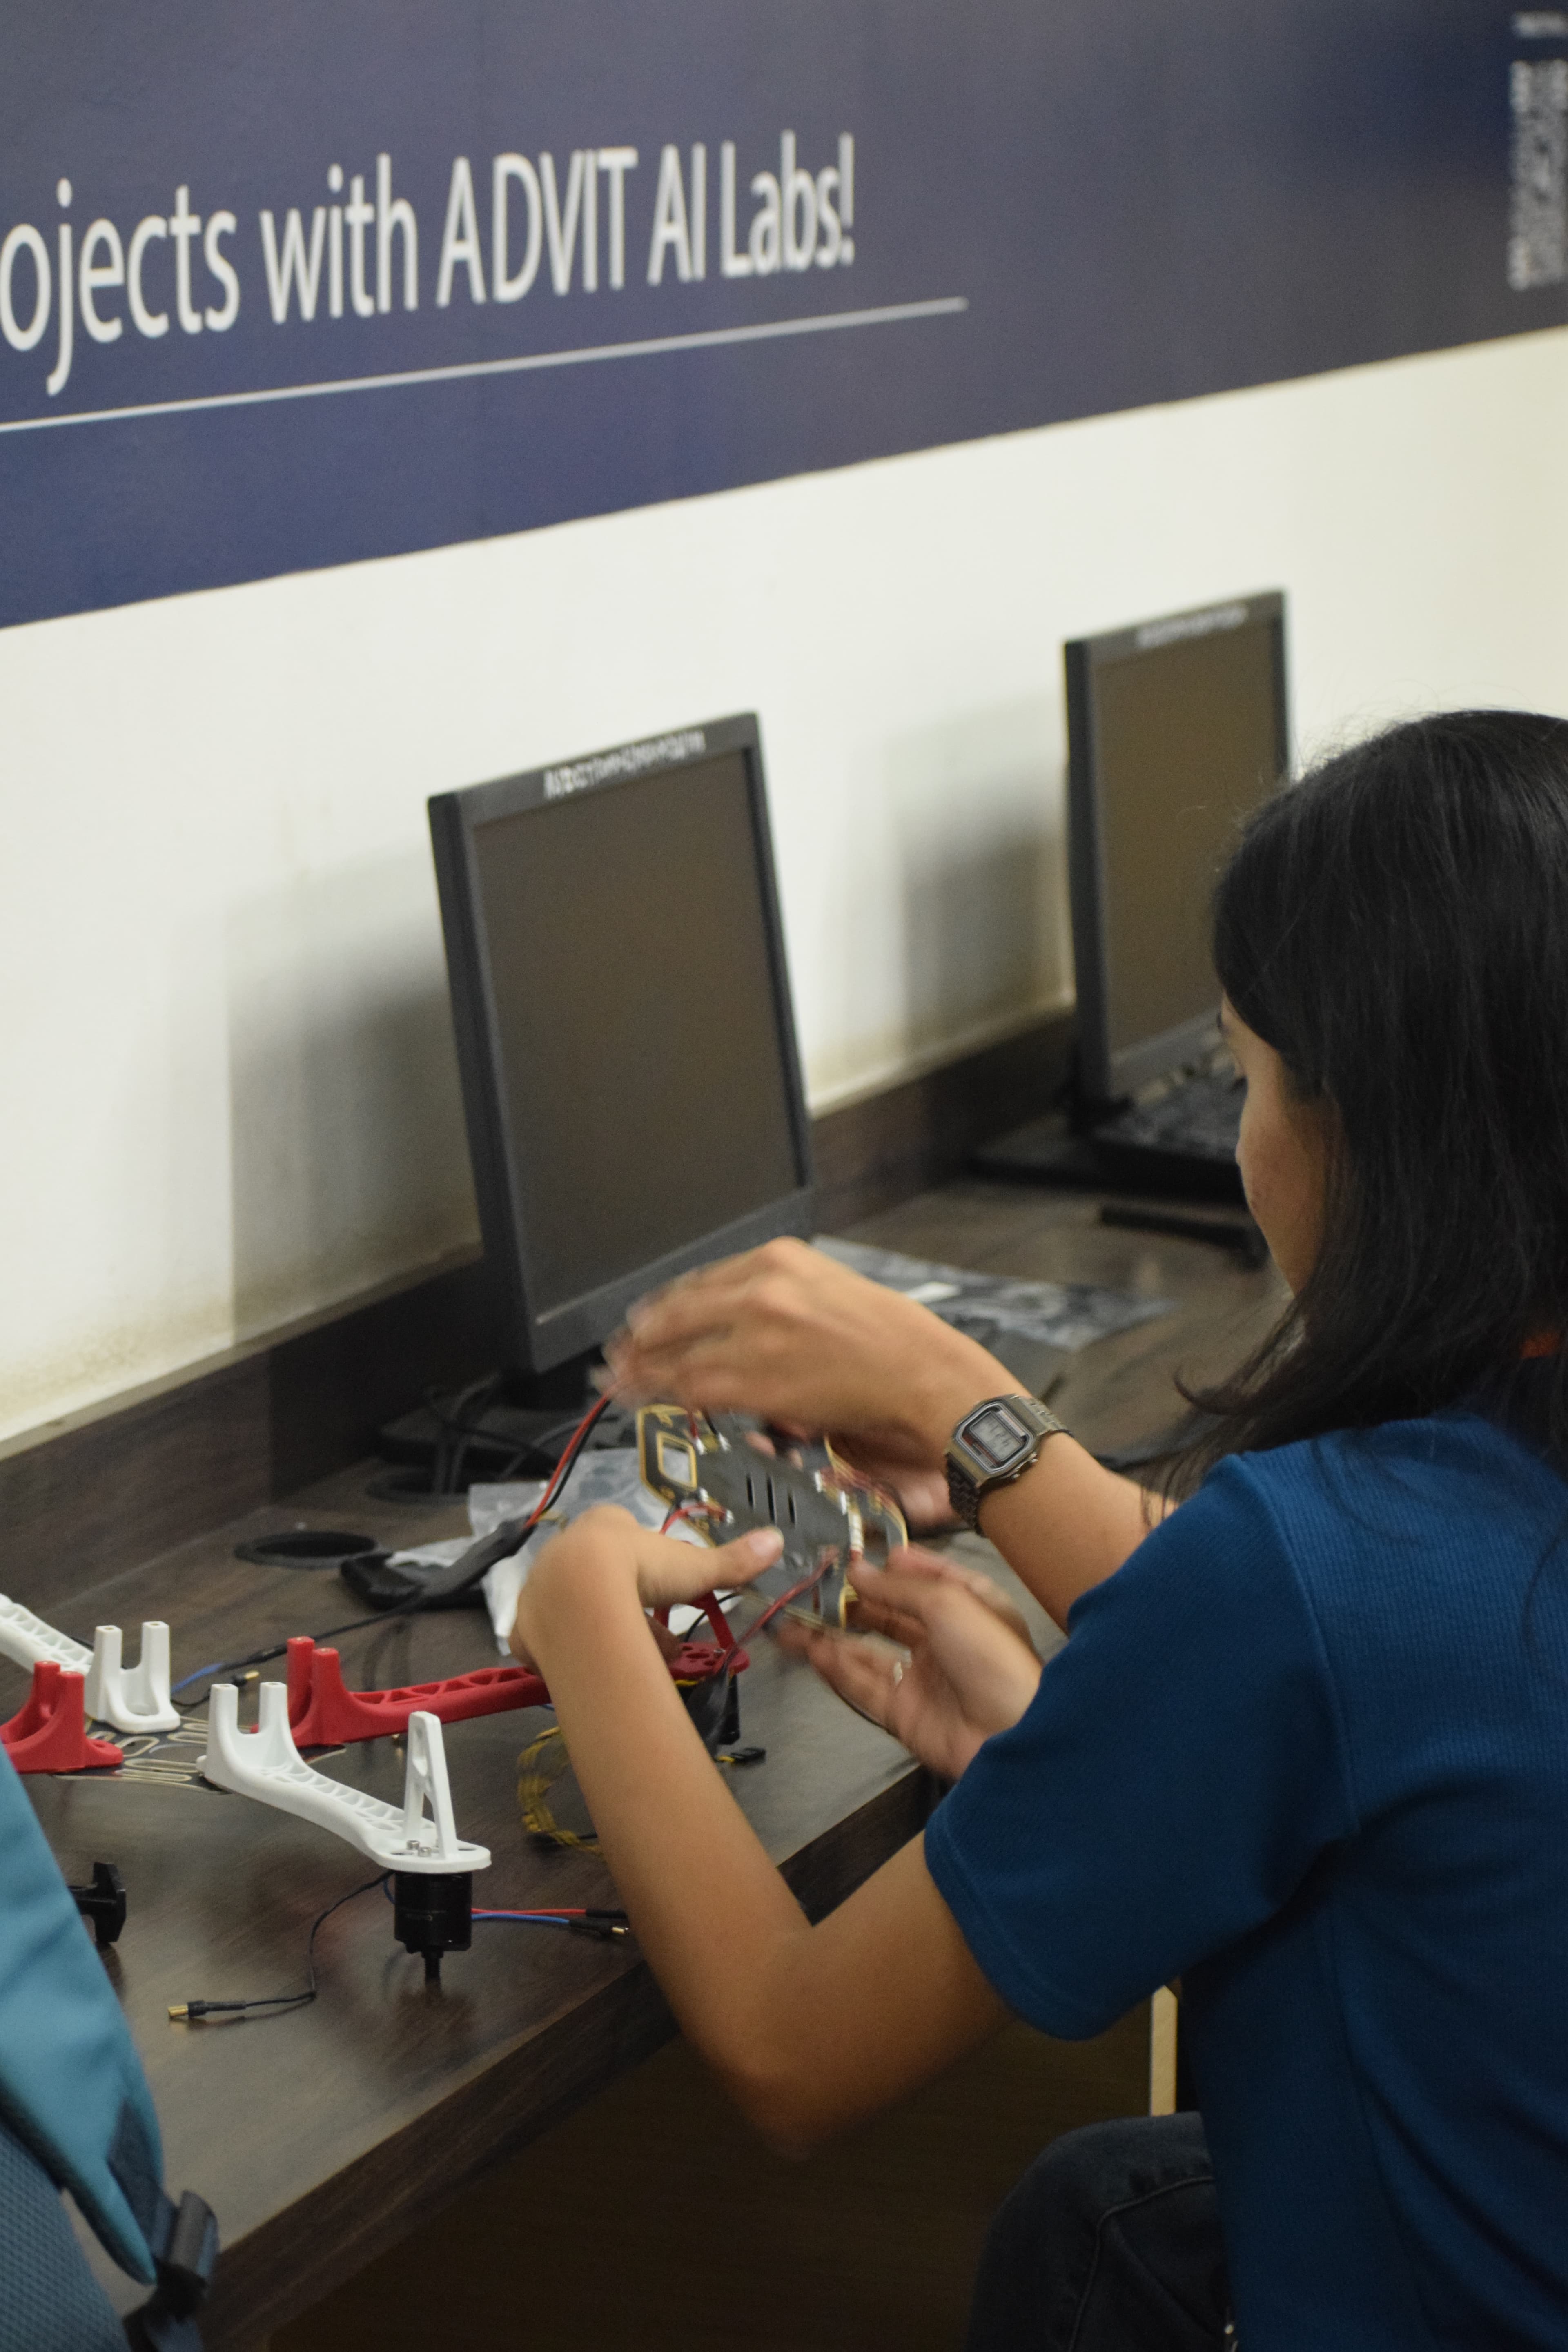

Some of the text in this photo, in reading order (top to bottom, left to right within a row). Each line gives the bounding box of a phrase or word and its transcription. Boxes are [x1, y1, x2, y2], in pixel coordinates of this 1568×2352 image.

[0, 130, 855, 396] ojects with ADVIT AI Labs!
